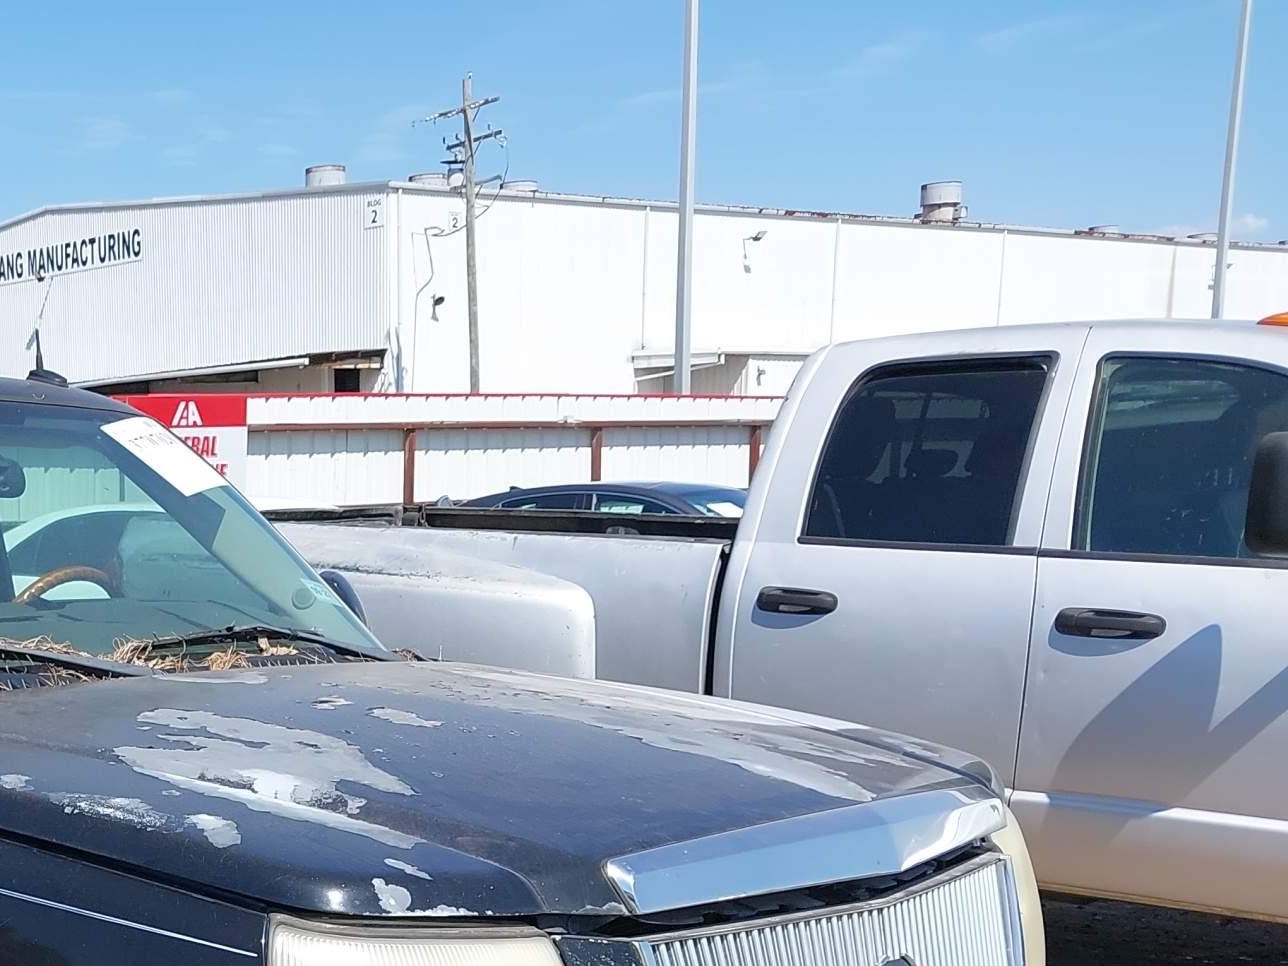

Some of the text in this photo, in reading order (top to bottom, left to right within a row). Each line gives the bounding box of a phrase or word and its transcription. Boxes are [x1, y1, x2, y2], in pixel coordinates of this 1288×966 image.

[371, 209, 378, 224] 2
[452, 217, 458, 228] 2
[27, 228, 142, 277] MANUFACTURING
